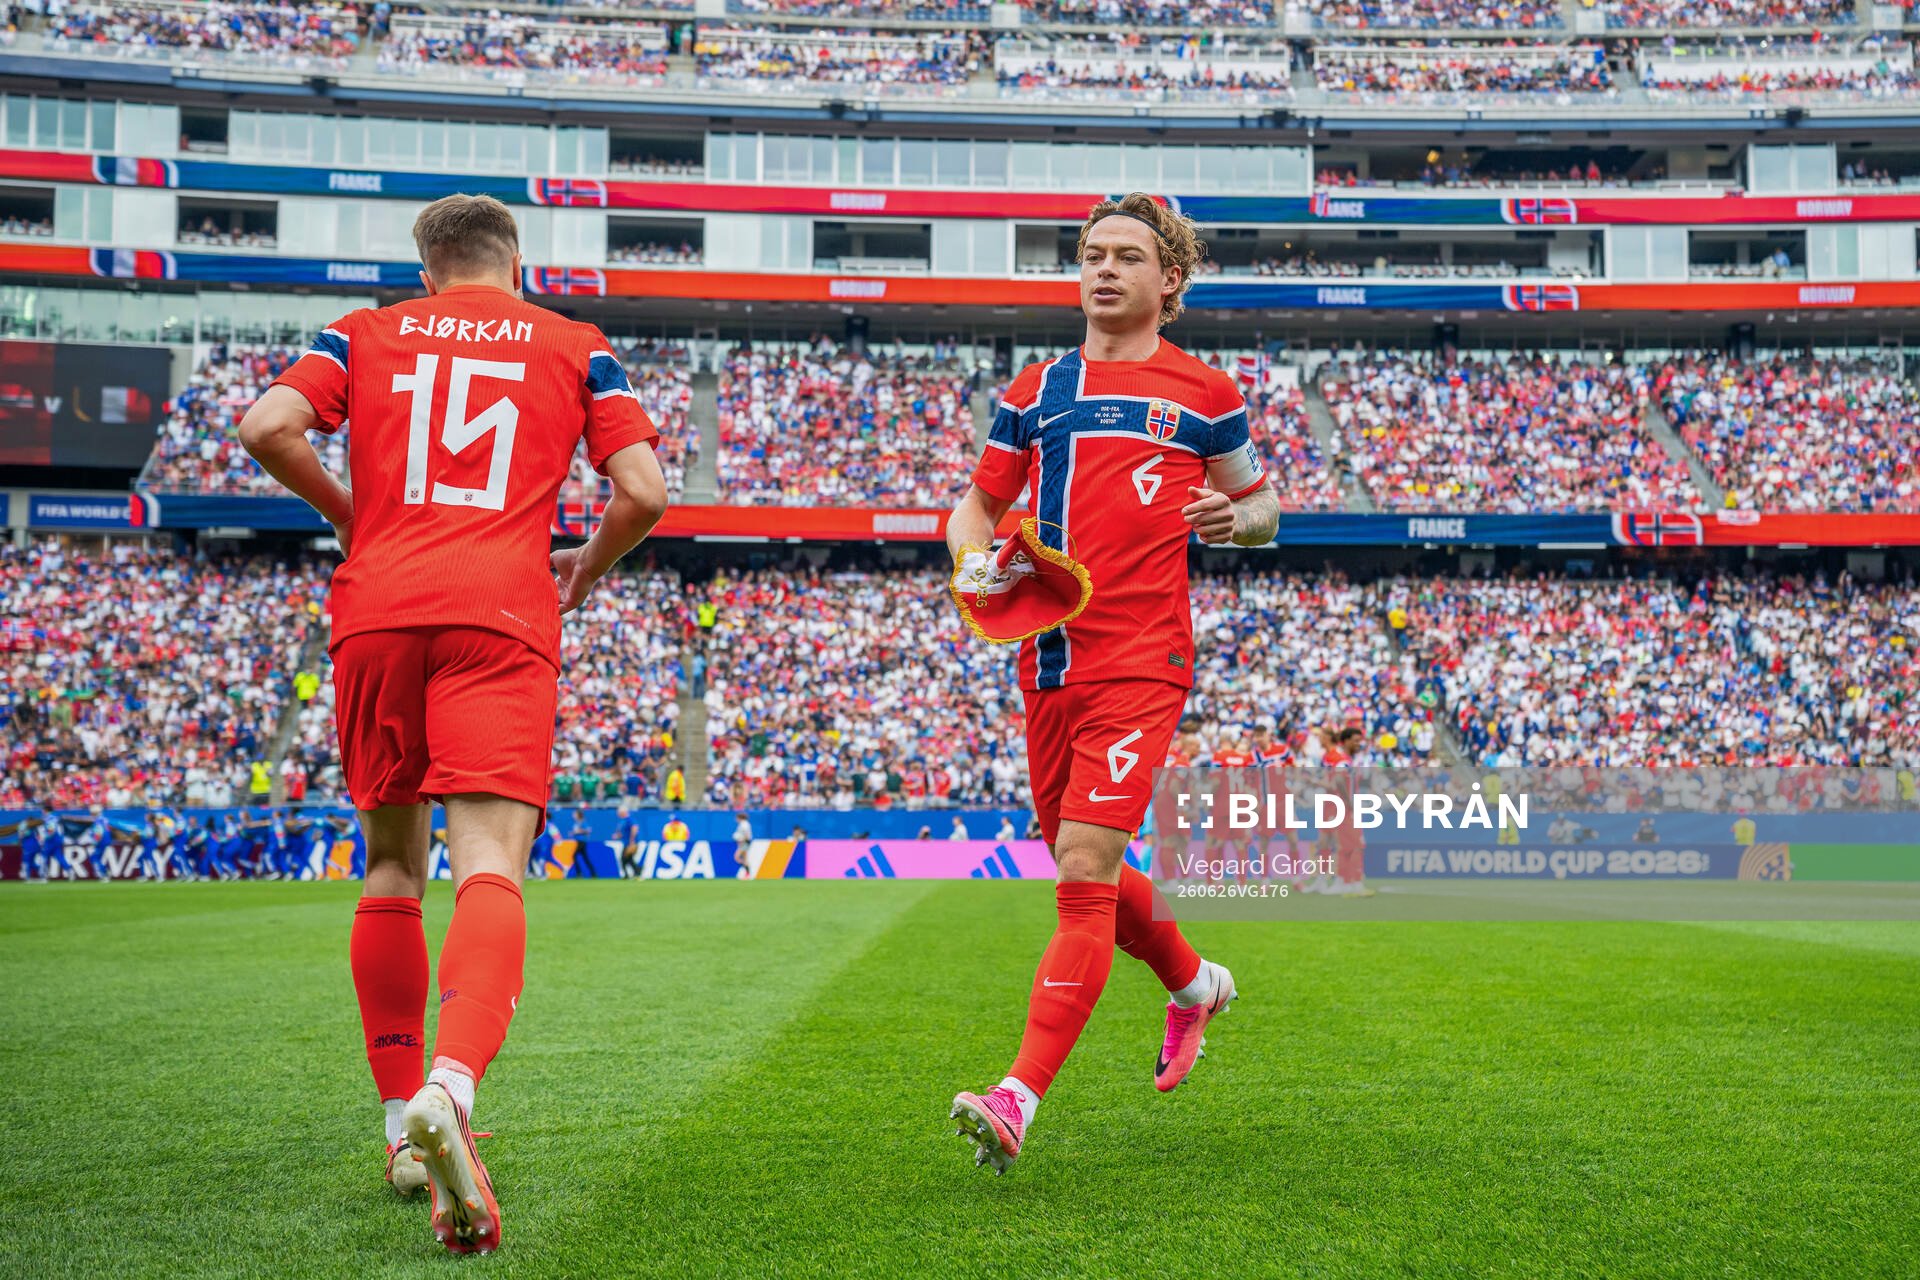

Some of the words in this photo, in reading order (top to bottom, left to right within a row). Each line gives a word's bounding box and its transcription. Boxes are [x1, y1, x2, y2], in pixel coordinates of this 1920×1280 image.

[329, 172, 382, 192] FRANCE
[1797, 199, 1852, 217] NORWAY
[327, 262, 381, 282] FRANCE
[1317, 287, 1366, 304] FRANCE
[1799, 285, 1855, 304] NORWAY
[400, 315, 533, 342] BJØRKAN
[392, 353, 526, 511] 15
[1131, 453, 1165, 506] 6
[37, 504, 68, 518] FIFA
[70, 505, 120, 519] WORLD
[873, 513, 939, 534] NORWAY
[1407, 518, 1466, 538] FRANCE
[1107, 728, 1143, 783] 6
[604, 840, 716, 879] VISA
[1387, 850, 1446, 874] FIFA
[1447, 850, 1547, 874] WORLD
[1550, 850, 1605, 876] CUP
[1607, 850, 1702, 874] 2026
